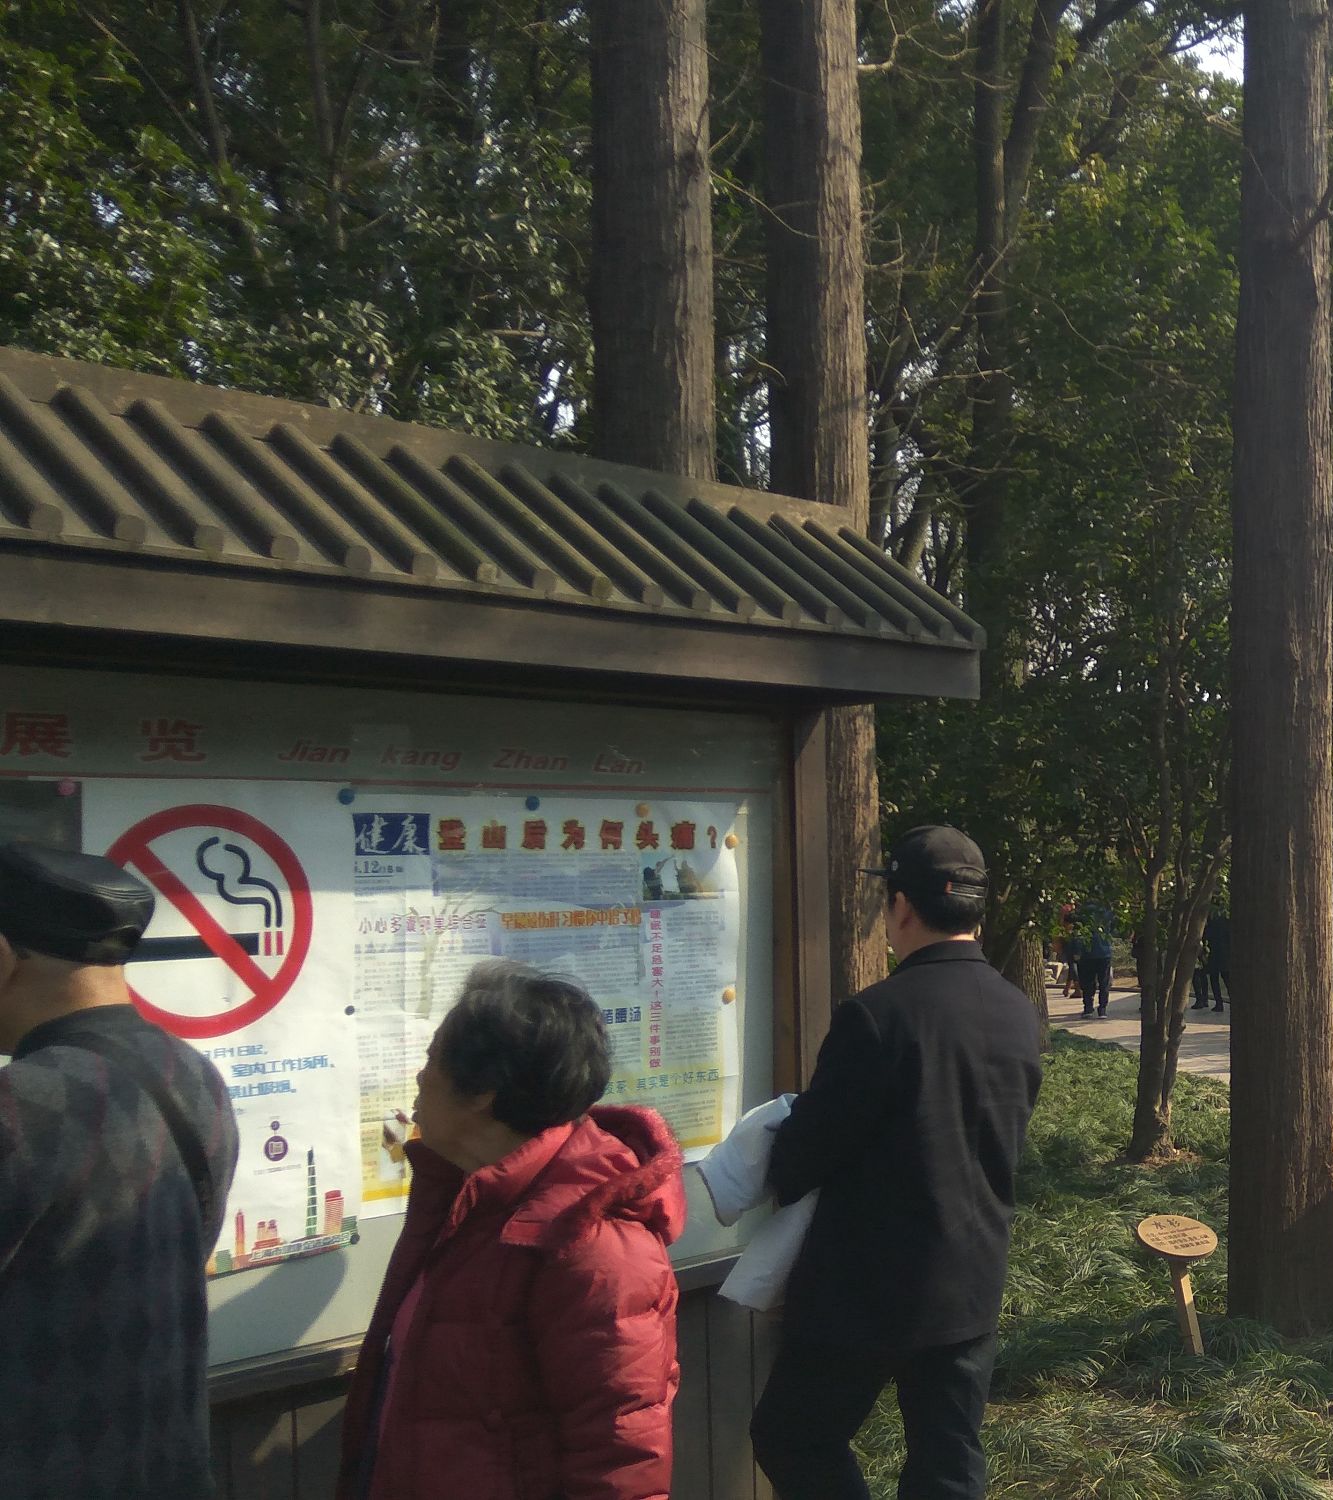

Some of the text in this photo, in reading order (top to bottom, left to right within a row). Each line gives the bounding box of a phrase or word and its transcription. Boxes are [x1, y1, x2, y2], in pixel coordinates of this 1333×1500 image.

[0, 712, 207, 762] 展览
[278, 738, 645, 775] Jian kang Zhan Lan
[355, 814, 427, 854] 健康
